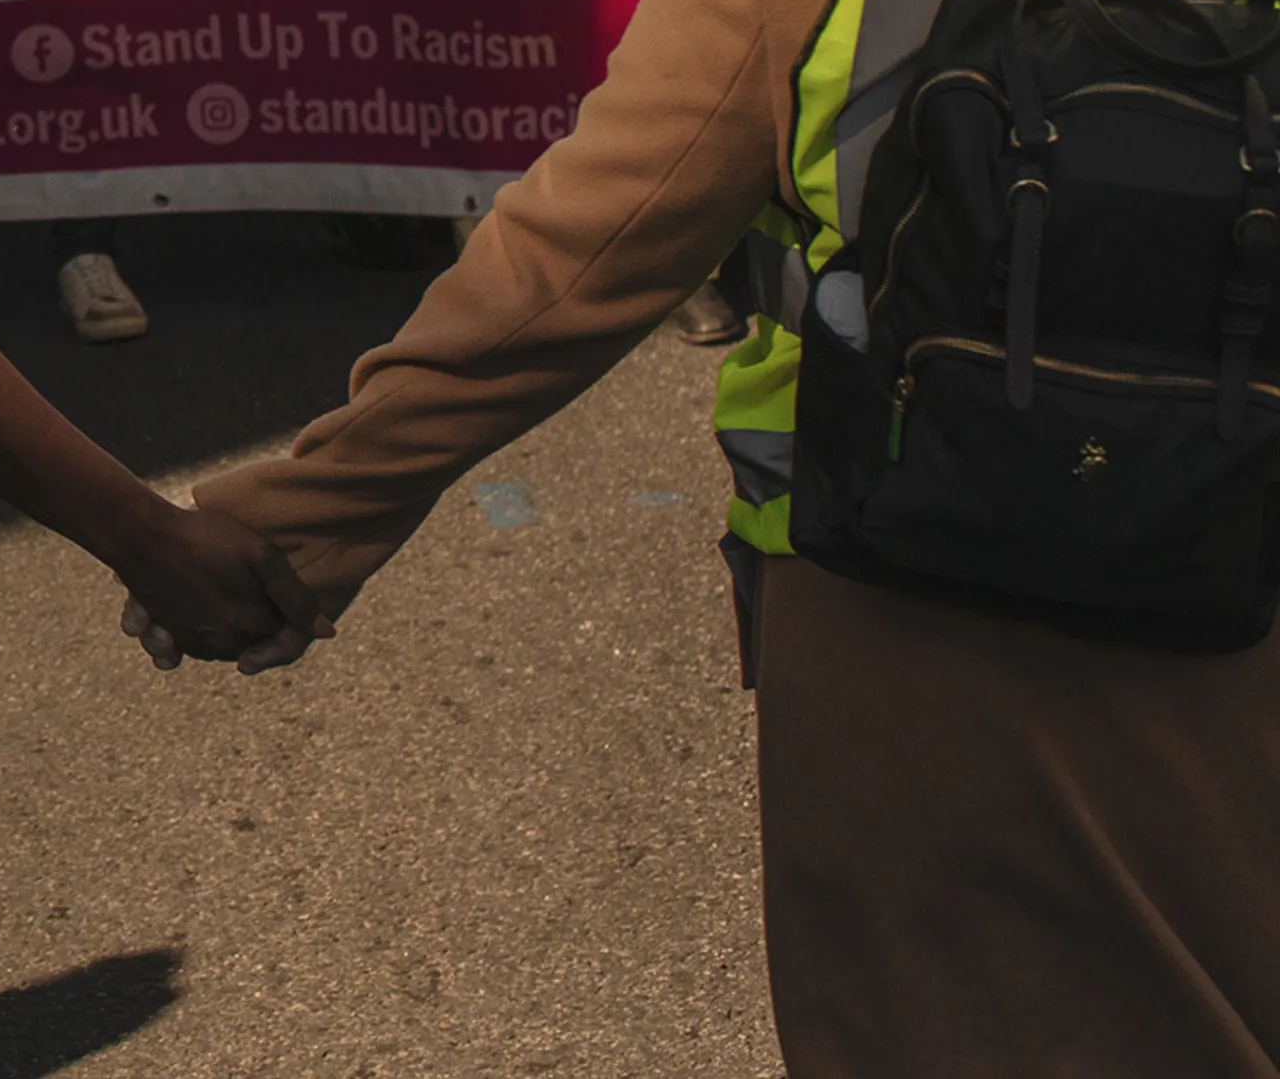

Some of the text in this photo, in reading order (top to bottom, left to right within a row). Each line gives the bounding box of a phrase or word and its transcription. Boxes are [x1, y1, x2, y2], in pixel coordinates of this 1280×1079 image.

[81, 13, 223, 70] Stand
[237, 11, 305, 71] Up
[317, 10, 379, 61] To
[392, 12, 557, 70] Racism
[260, 85, 578, 149] standuptoraci
